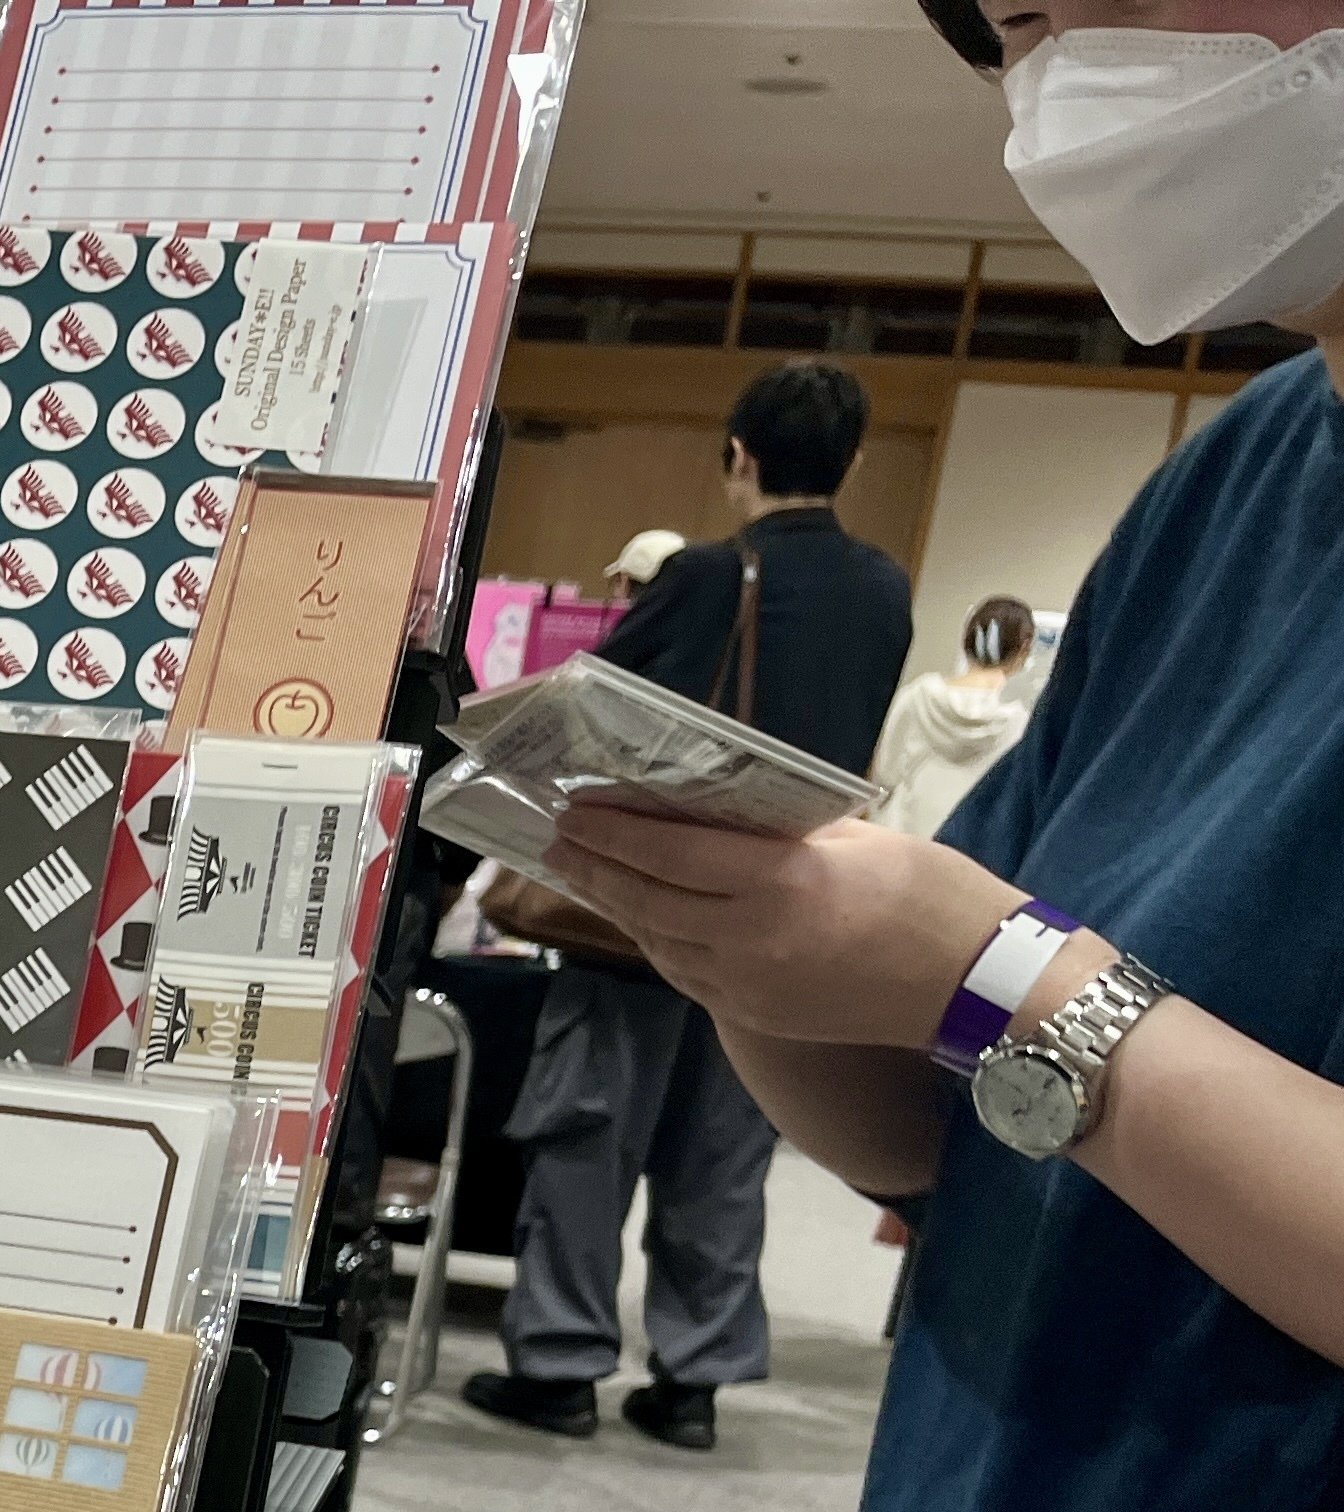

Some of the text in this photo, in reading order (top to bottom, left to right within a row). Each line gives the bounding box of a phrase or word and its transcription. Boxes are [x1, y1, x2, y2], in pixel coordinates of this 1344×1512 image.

[250, 257, 308, 432] Original Design Paper
[294, 317, 317, 360] Sheets
[294, 539, 345, 644] りんご
